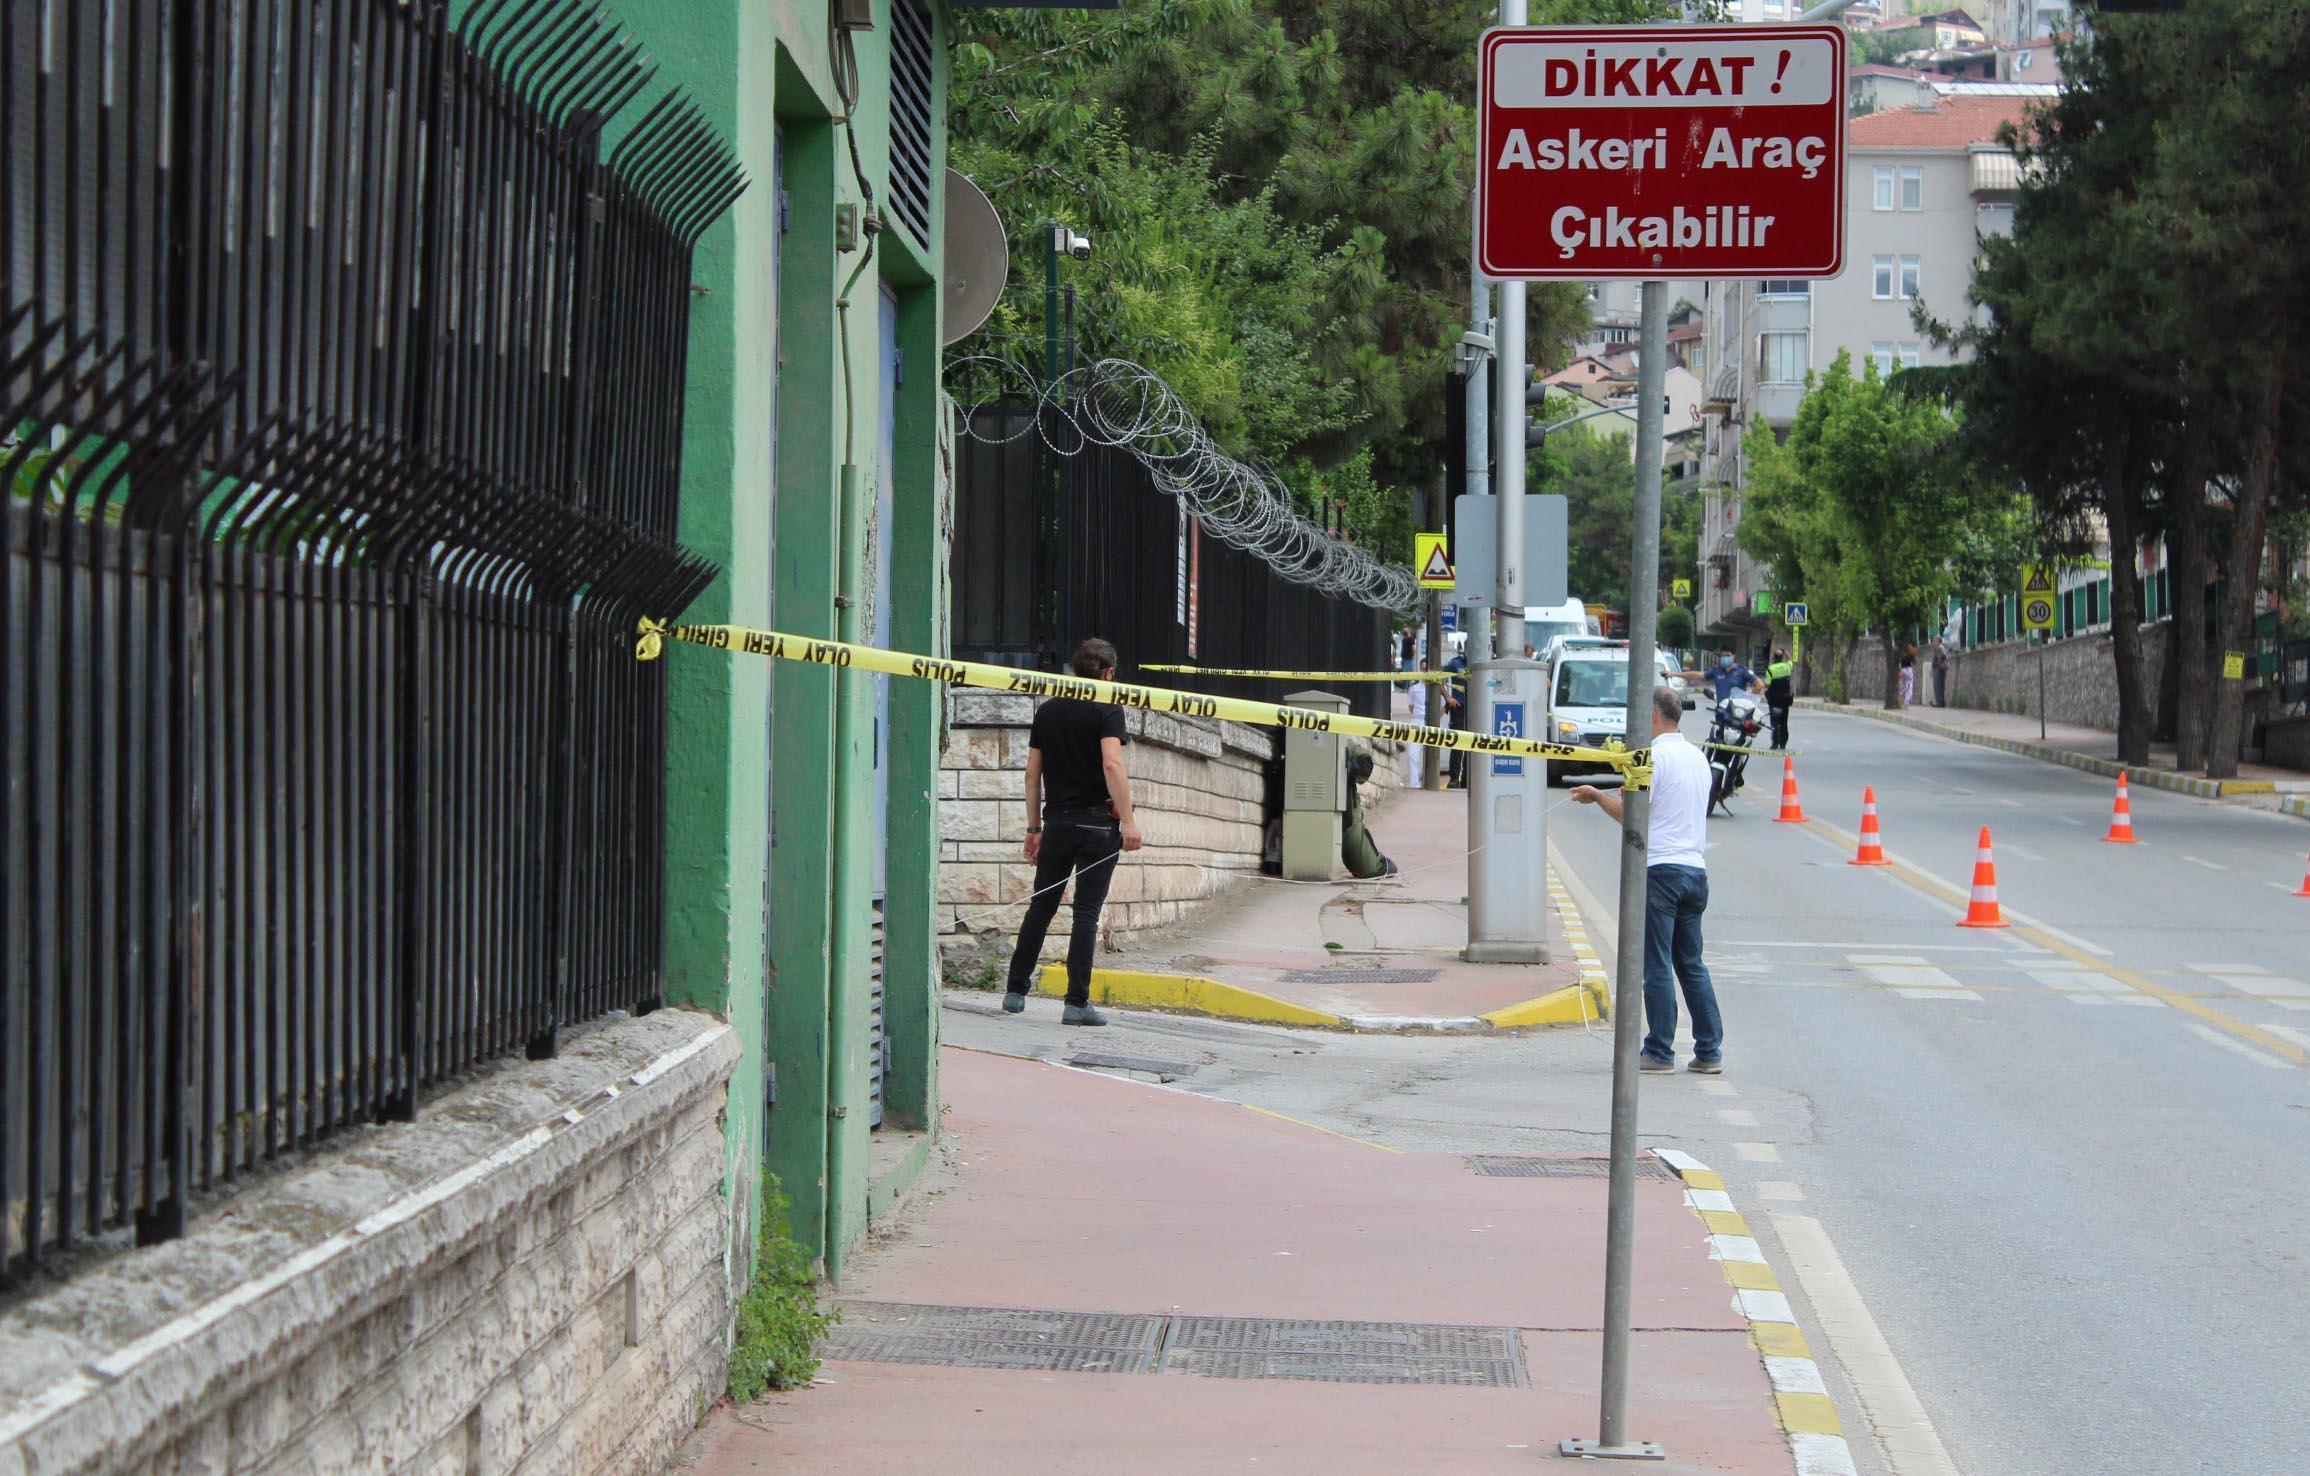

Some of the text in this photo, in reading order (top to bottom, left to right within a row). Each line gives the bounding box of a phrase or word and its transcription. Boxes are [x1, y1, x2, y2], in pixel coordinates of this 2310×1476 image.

[1544, 48, 1792, 97] DİKKAT !
[1497, 126, 1826, 179] Askeri Araç
[1550, 205, 1775, 259] Çıkabilir
[2031, 605, 2046, 618] 30
[667, 624, 729, 650] GIRILM
[743, 631, 785, 658] YERI
[803, 640, 851, 667] OLAY
[912, 657, 966, 684] POLIS
[1008, 672, 1097, 701] GIRILMEZ
[1111, 685, 1152, 709] YERI
[1170, 693, 1217, 718] OLAY
[1276, 707, 1330, 732] POLIS
[1371, 719, 1458, 748] GIRILMEZ
